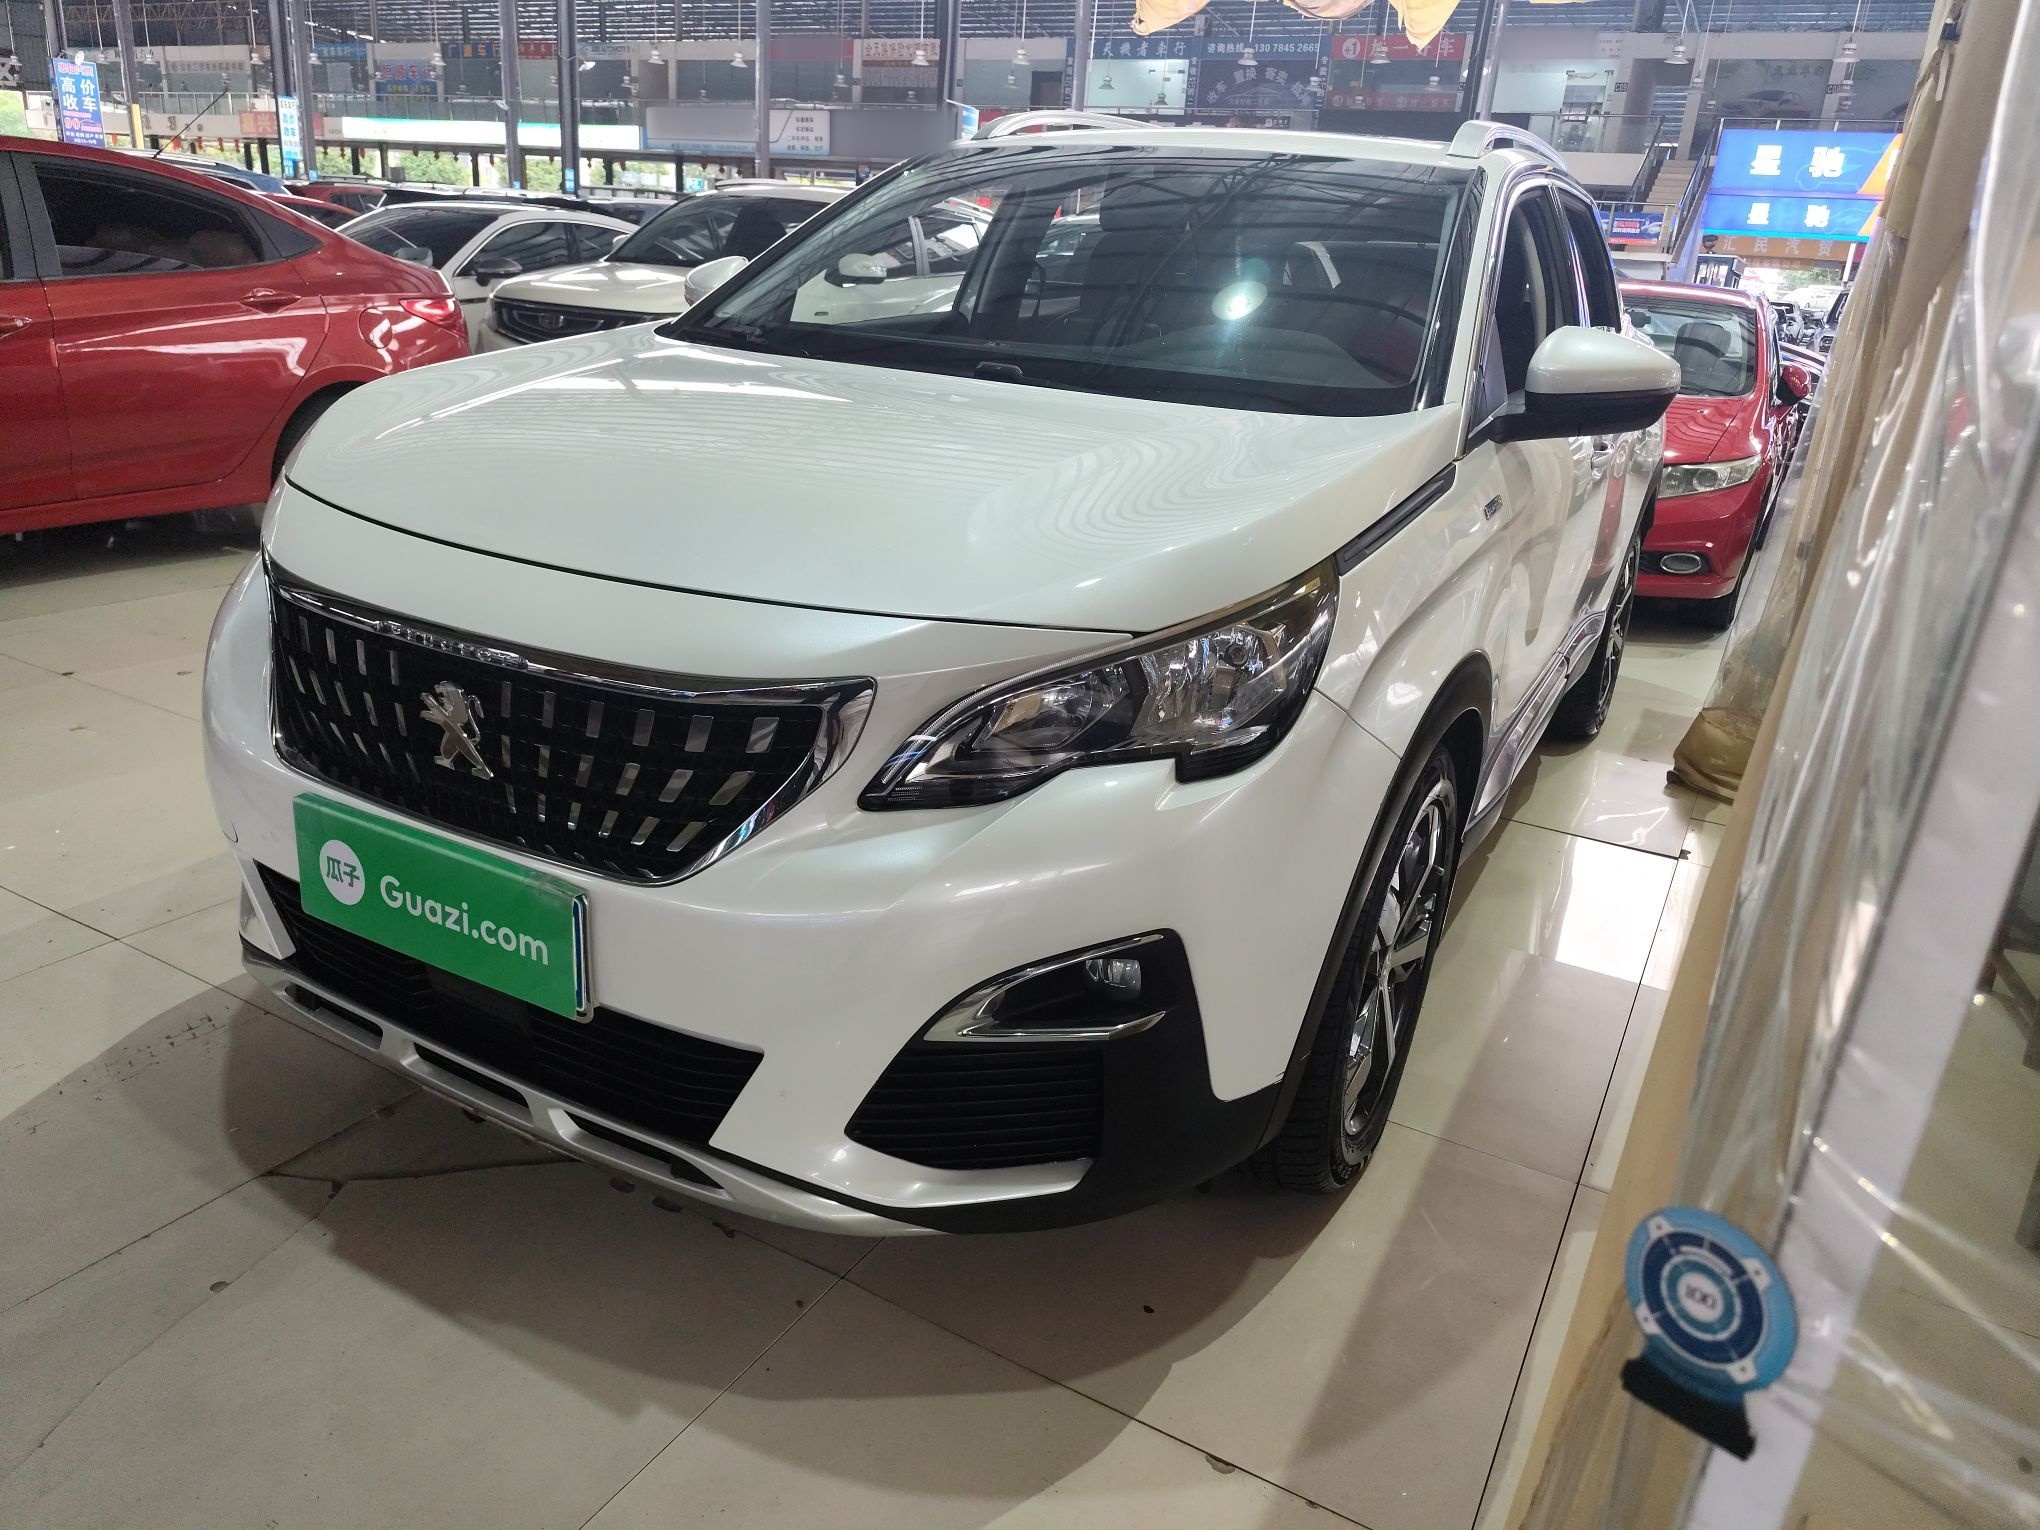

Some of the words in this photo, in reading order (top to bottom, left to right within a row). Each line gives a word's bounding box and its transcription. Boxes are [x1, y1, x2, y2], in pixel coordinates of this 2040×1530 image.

[1207, 42, 1245, 53] 咨询热线
[1254, 43, 1271, 53] 130
[1272, 43, 1295, 53] 7845
[60, 76, 96, 97] 高价
[1615, 83, 1628, 92] C09
[62, 95, 98, 113] 收车
[1722, 235, 1834, 256] 汇民汽贸
[325, 855, 361, 888] 瓜子
[379, 874, 550, 966] Guazi.com
